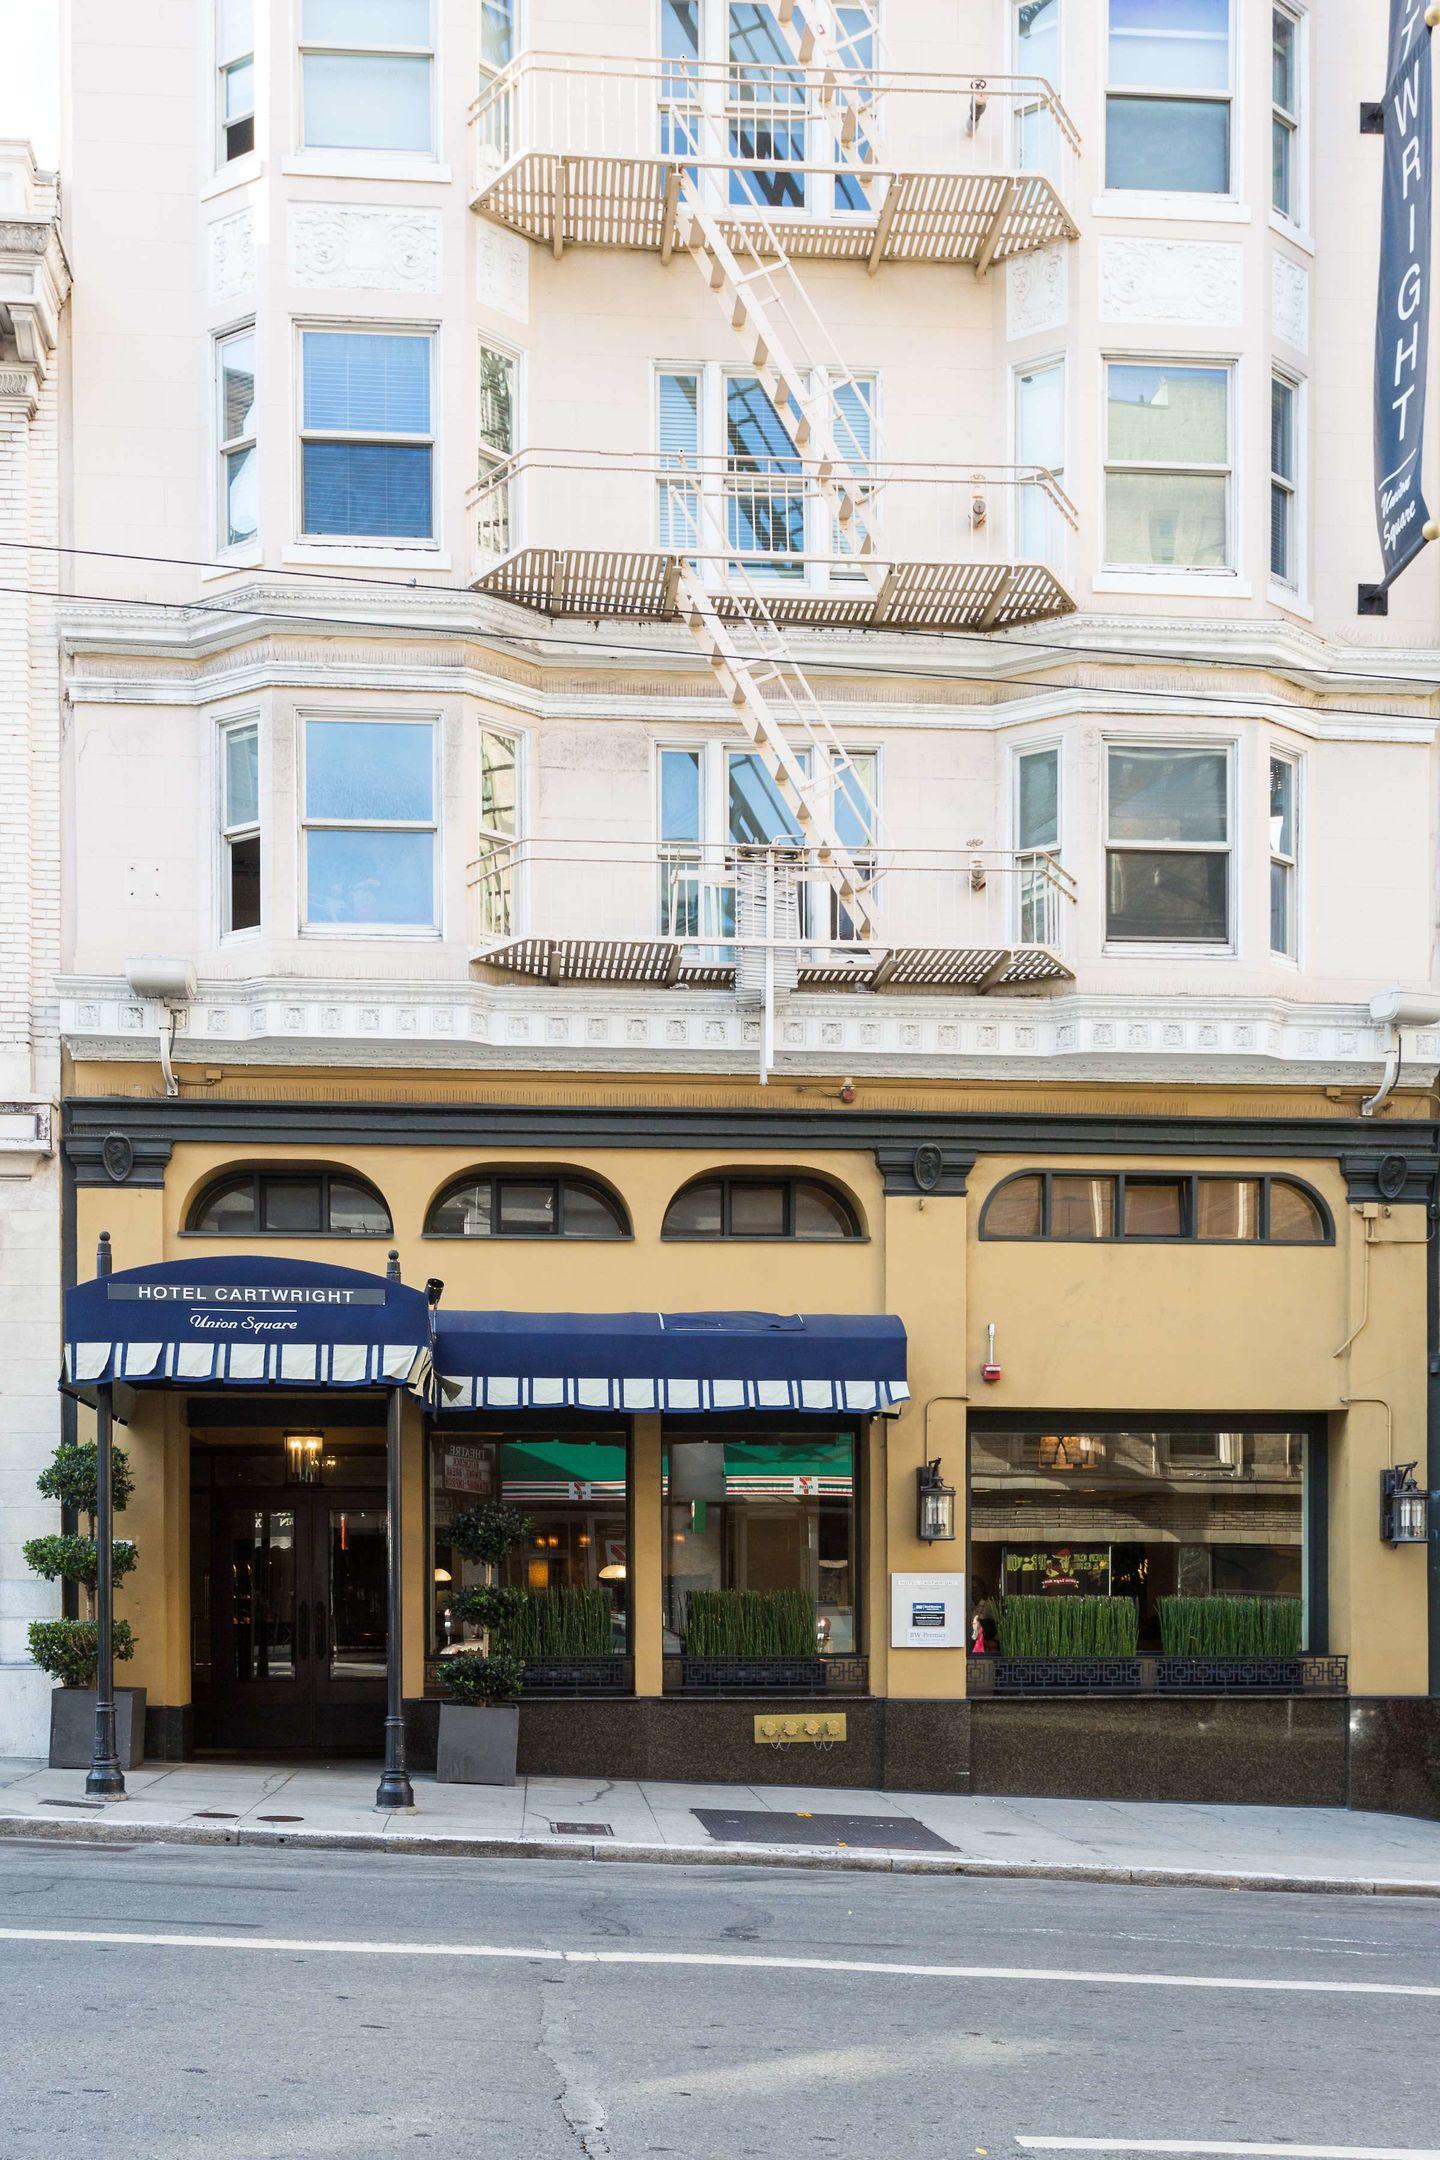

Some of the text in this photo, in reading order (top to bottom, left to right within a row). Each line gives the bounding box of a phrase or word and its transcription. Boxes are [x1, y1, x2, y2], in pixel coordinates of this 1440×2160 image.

[1392, 0, 1422, 441] TWRIGHT
[1383, 500, 1416, 551] Square
[138, 1286, 354, 1303] HOTEL CARTWRIGHT
[190, 1315, 298, 1334] Union Square
